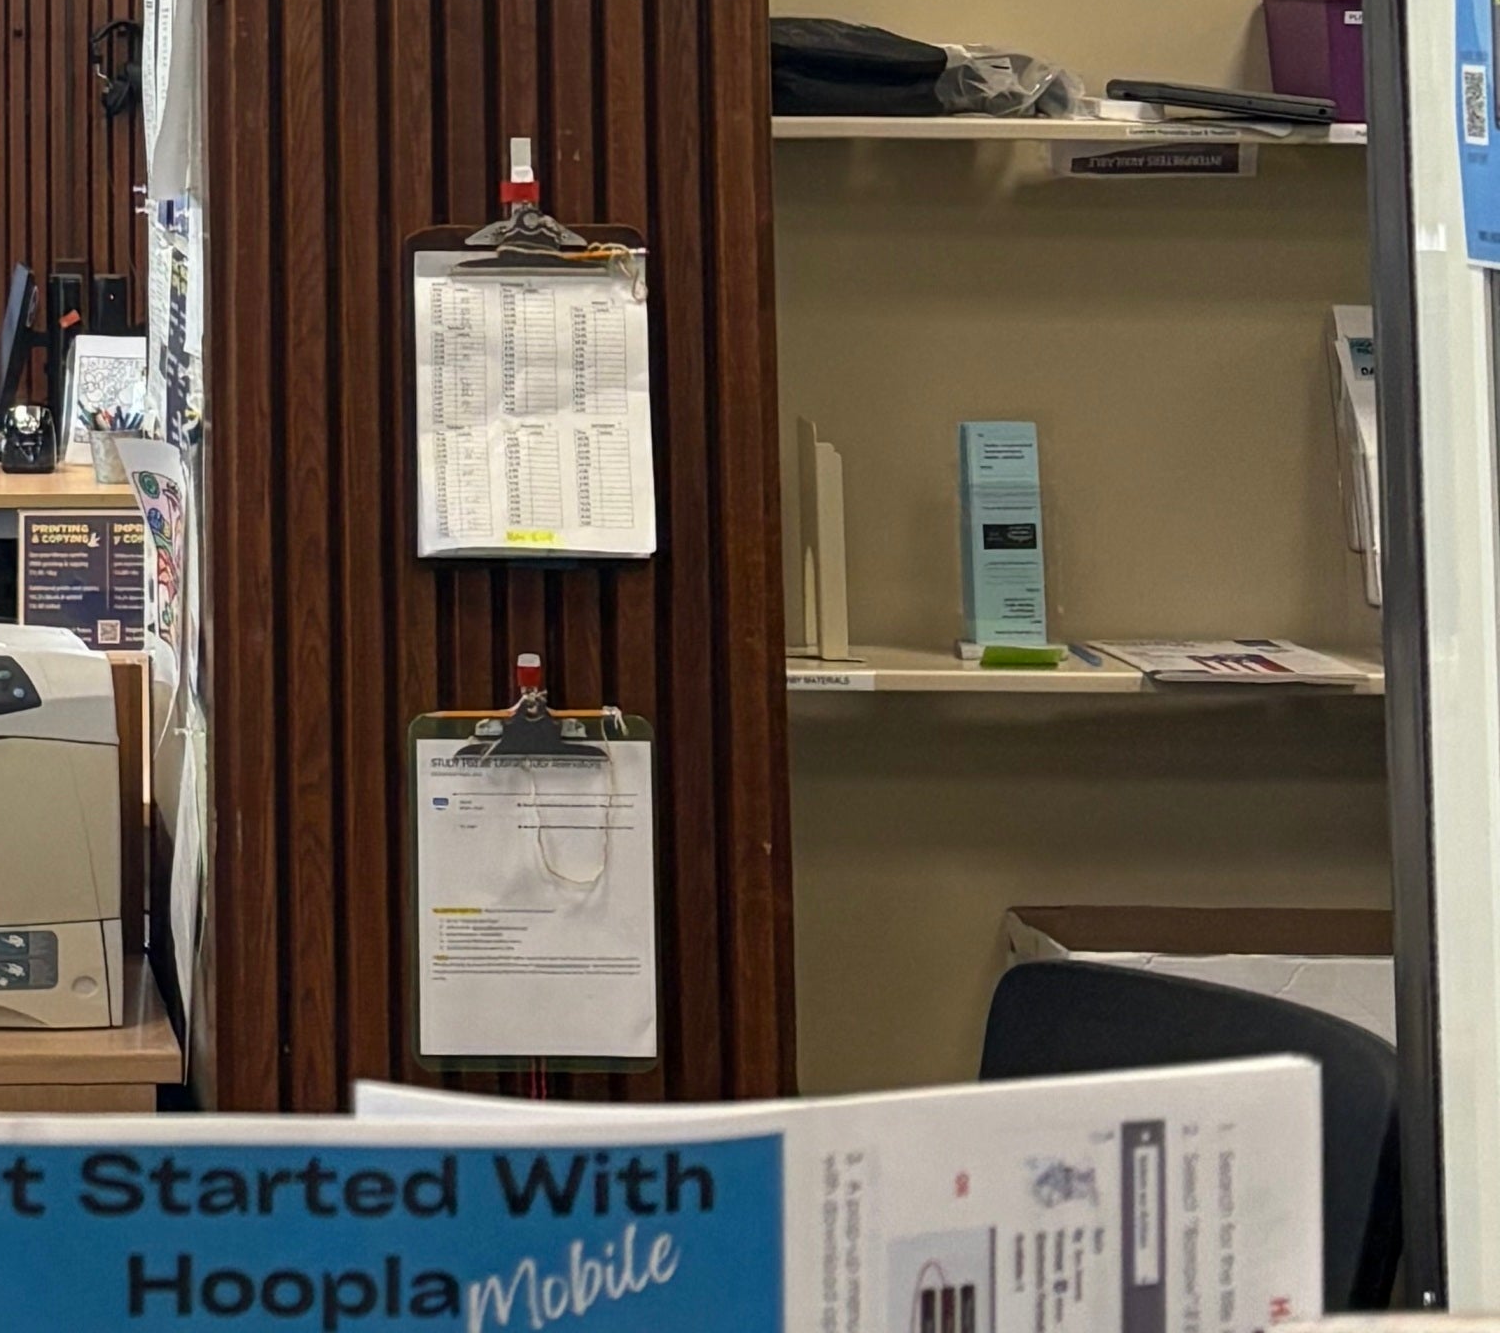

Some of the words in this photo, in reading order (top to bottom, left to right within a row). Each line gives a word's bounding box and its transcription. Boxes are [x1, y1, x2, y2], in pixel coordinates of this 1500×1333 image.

[804, 675, 850, 686] MATERIALS
[78, 1152, 459, 1219] Started
[493, 1149, 716, 1219] With
[126, 1254, 461, 1333] Hoopla
[465, 1222, 681, 1333] Mobile
